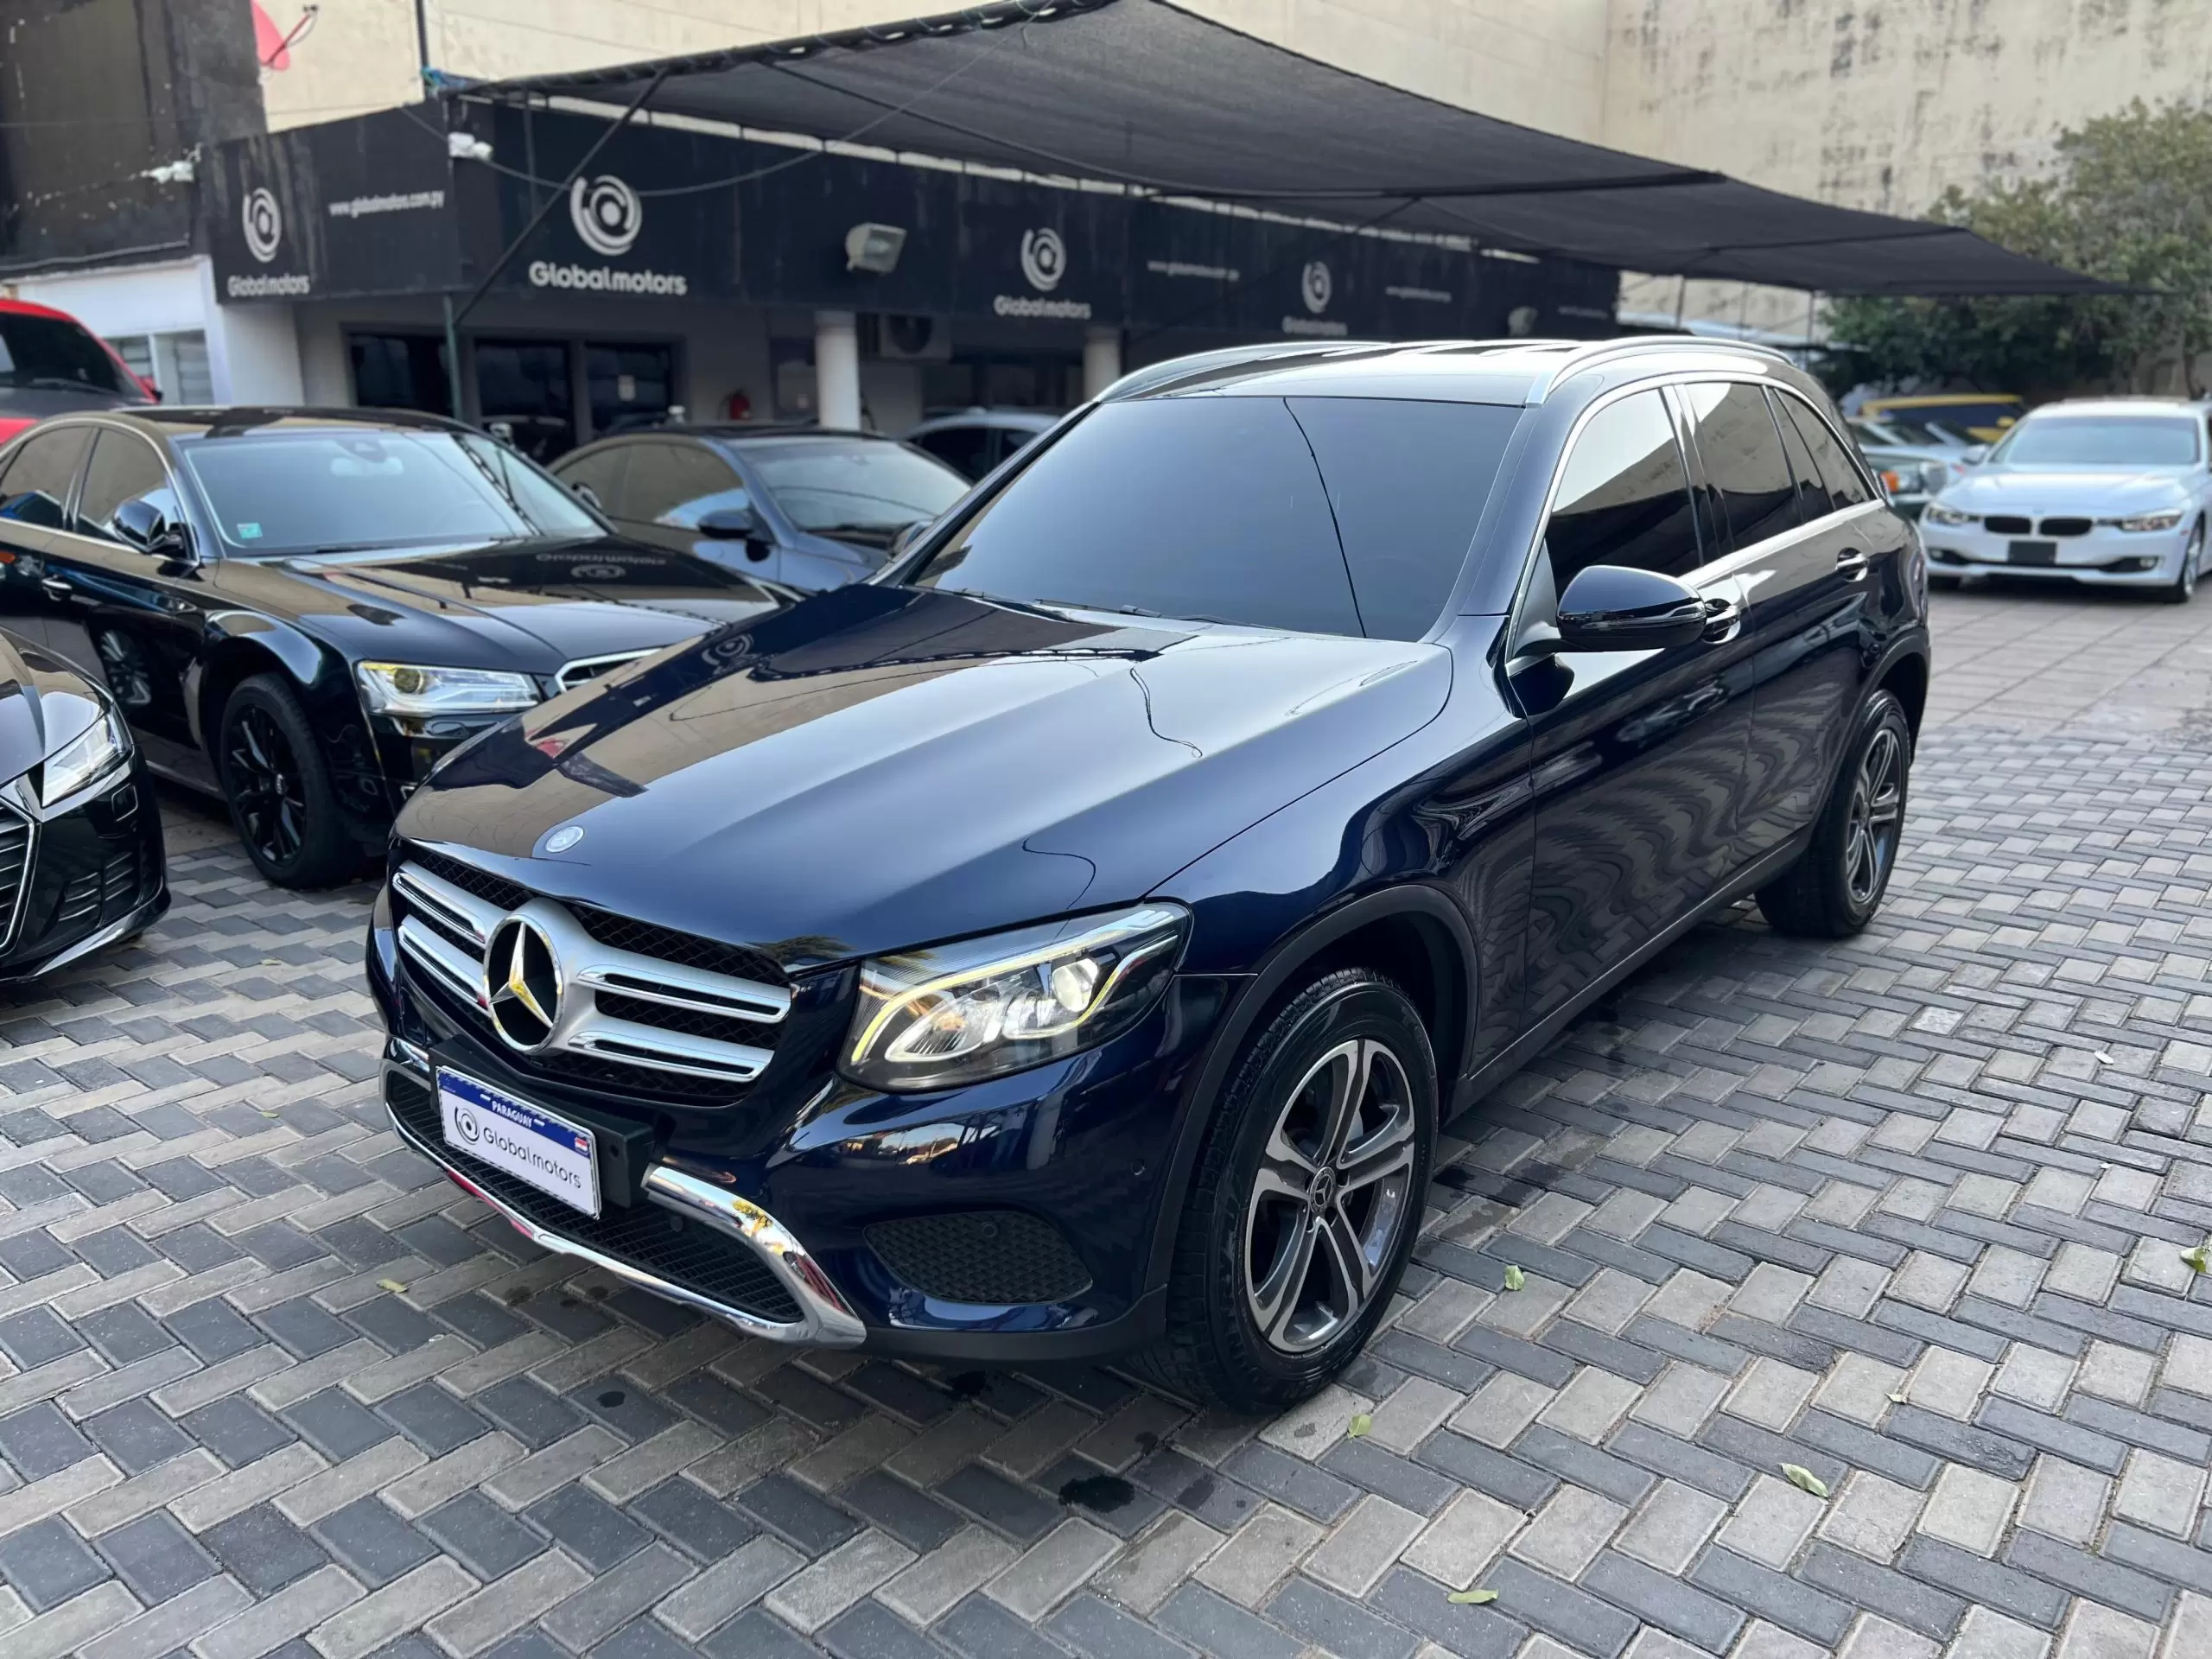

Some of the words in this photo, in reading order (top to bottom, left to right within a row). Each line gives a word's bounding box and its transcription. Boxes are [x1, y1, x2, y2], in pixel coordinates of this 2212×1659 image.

[227, 273, 310, 296] Globalmotors
[528, 260, 688, 296] Globalmotors
[993, 295, 1091, 320] Globalmotors
[491, 1100, 532, 1128] PARAGUAY
[483, 1126, 582, 1190] Globalmotors
